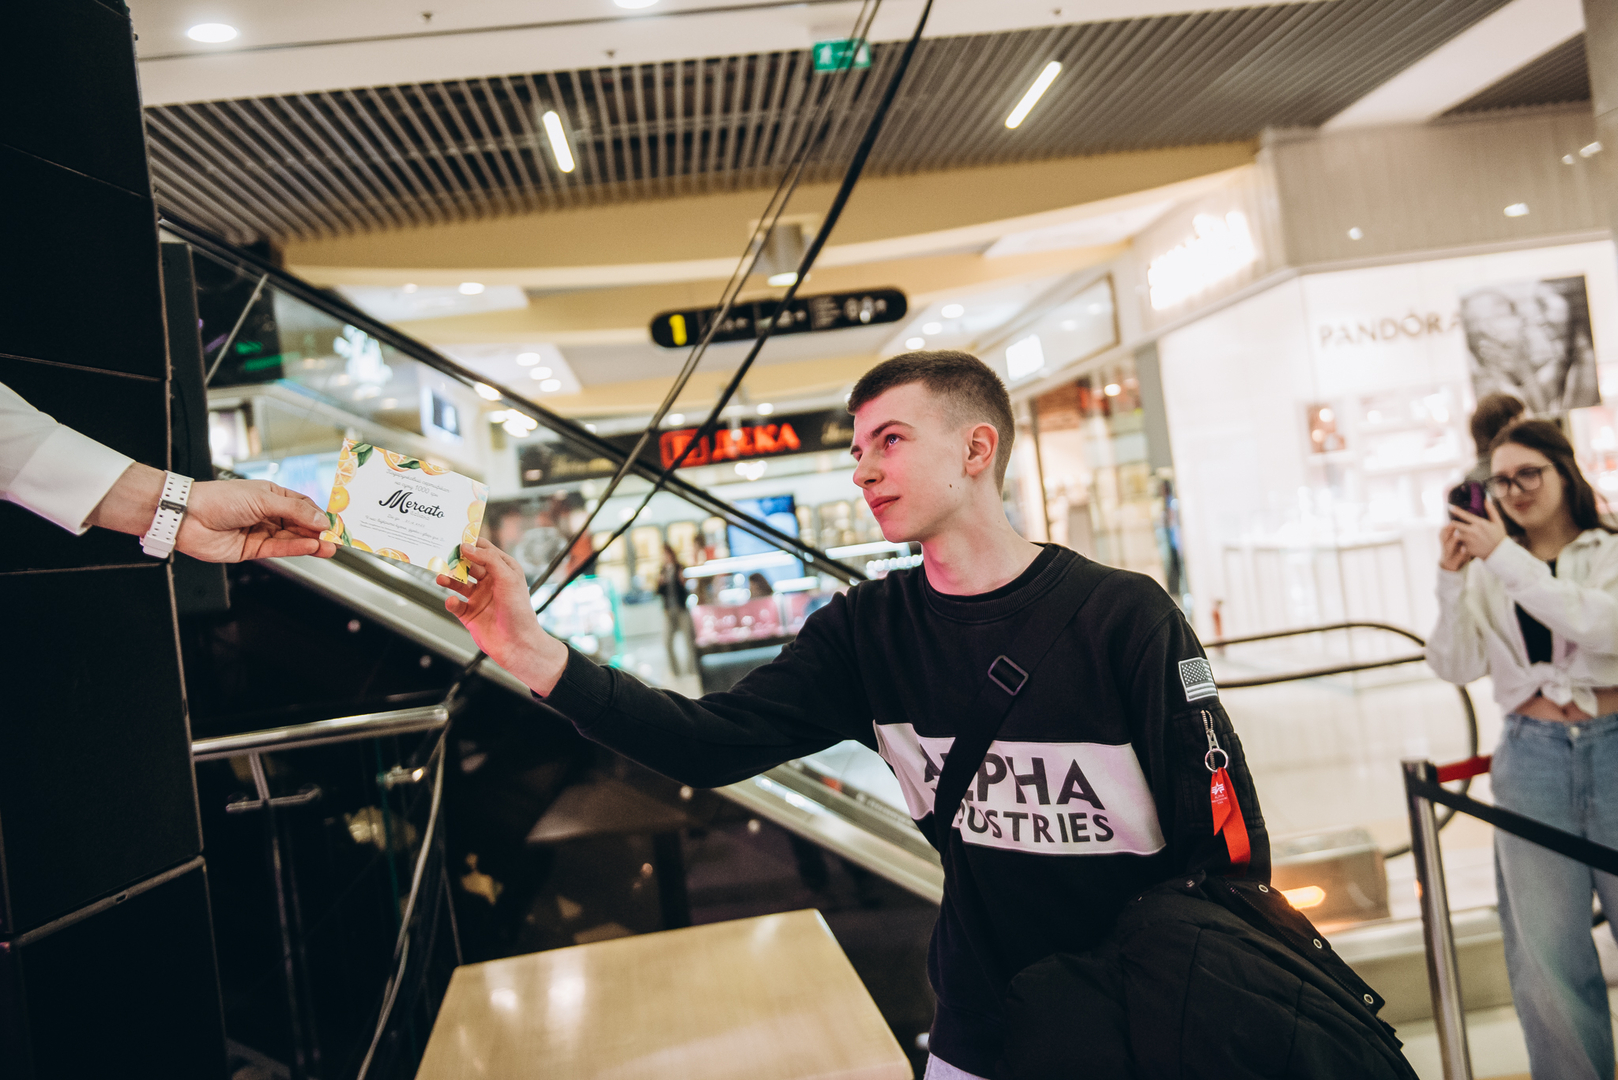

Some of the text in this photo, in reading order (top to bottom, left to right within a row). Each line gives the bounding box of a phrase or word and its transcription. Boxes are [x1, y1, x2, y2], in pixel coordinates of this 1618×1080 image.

[378, 489, 445, 519] Mercato
[415, 484, 430, 494] 1000
[919, 743, 1106, 810] APHA
